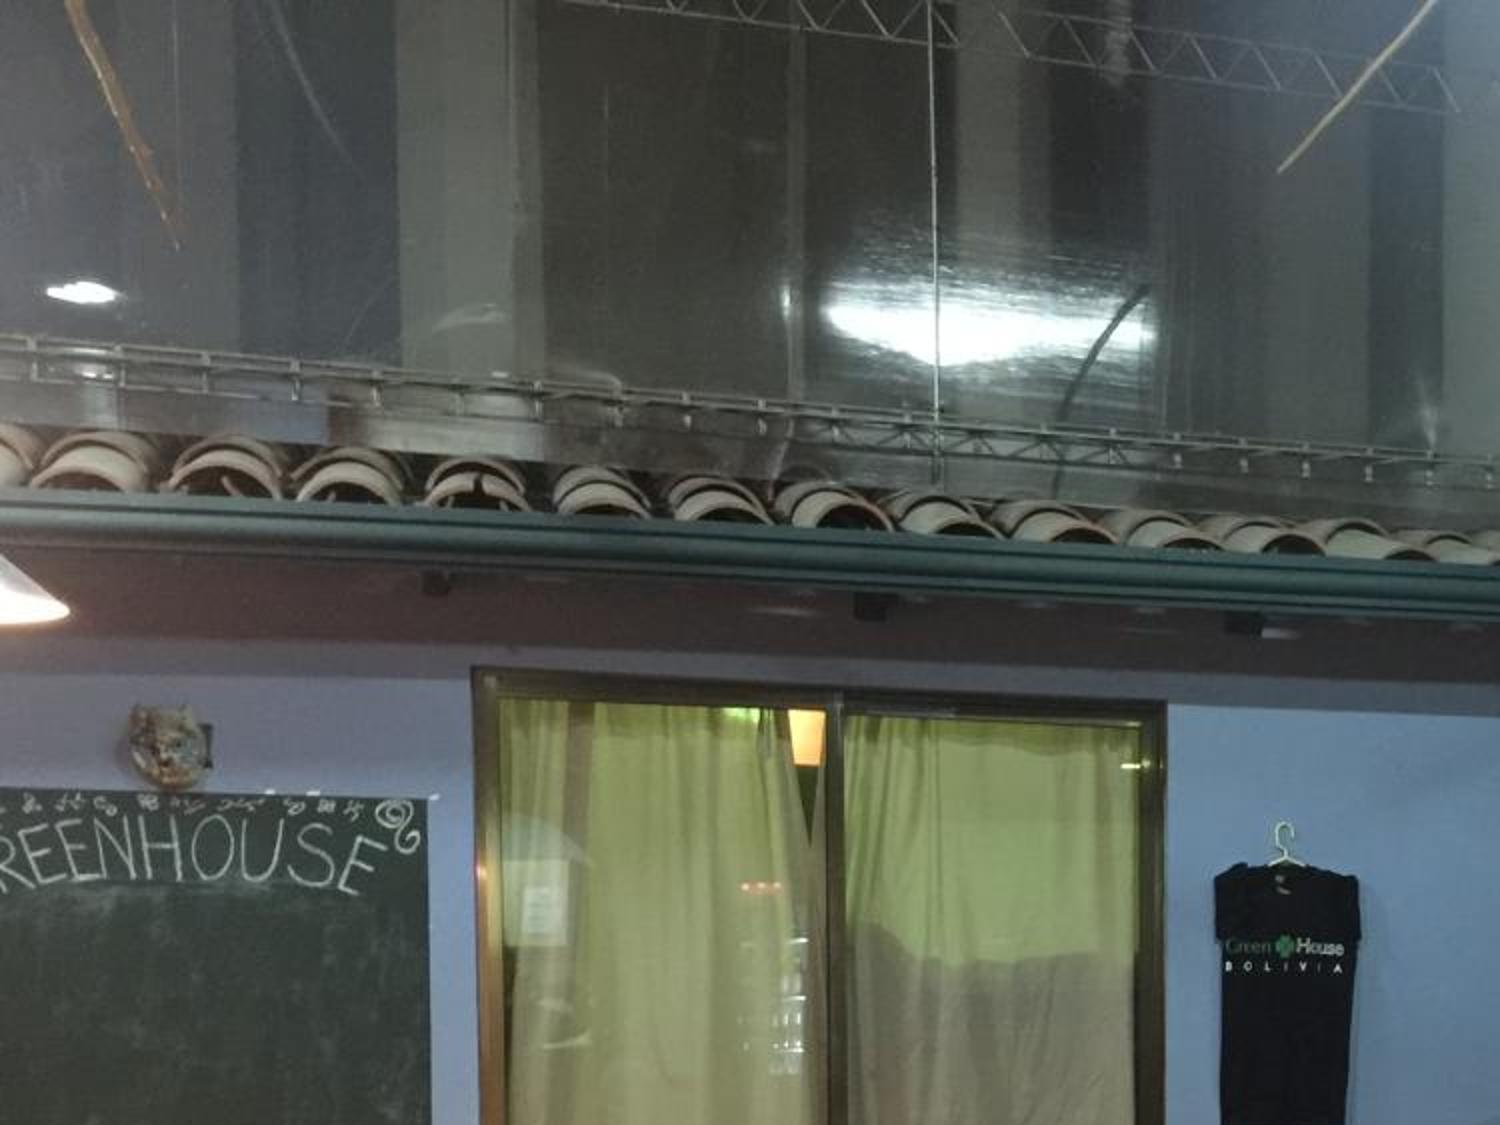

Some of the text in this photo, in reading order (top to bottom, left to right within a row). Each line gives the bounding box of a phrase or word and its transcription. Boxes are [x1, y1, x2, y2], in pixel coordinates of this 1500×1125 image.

[0, 814, 389, 896] REENHOUSE
[1225, 937, 1345, 957] Green House
[1225, 960, 1343, 974] BOLIVIA
